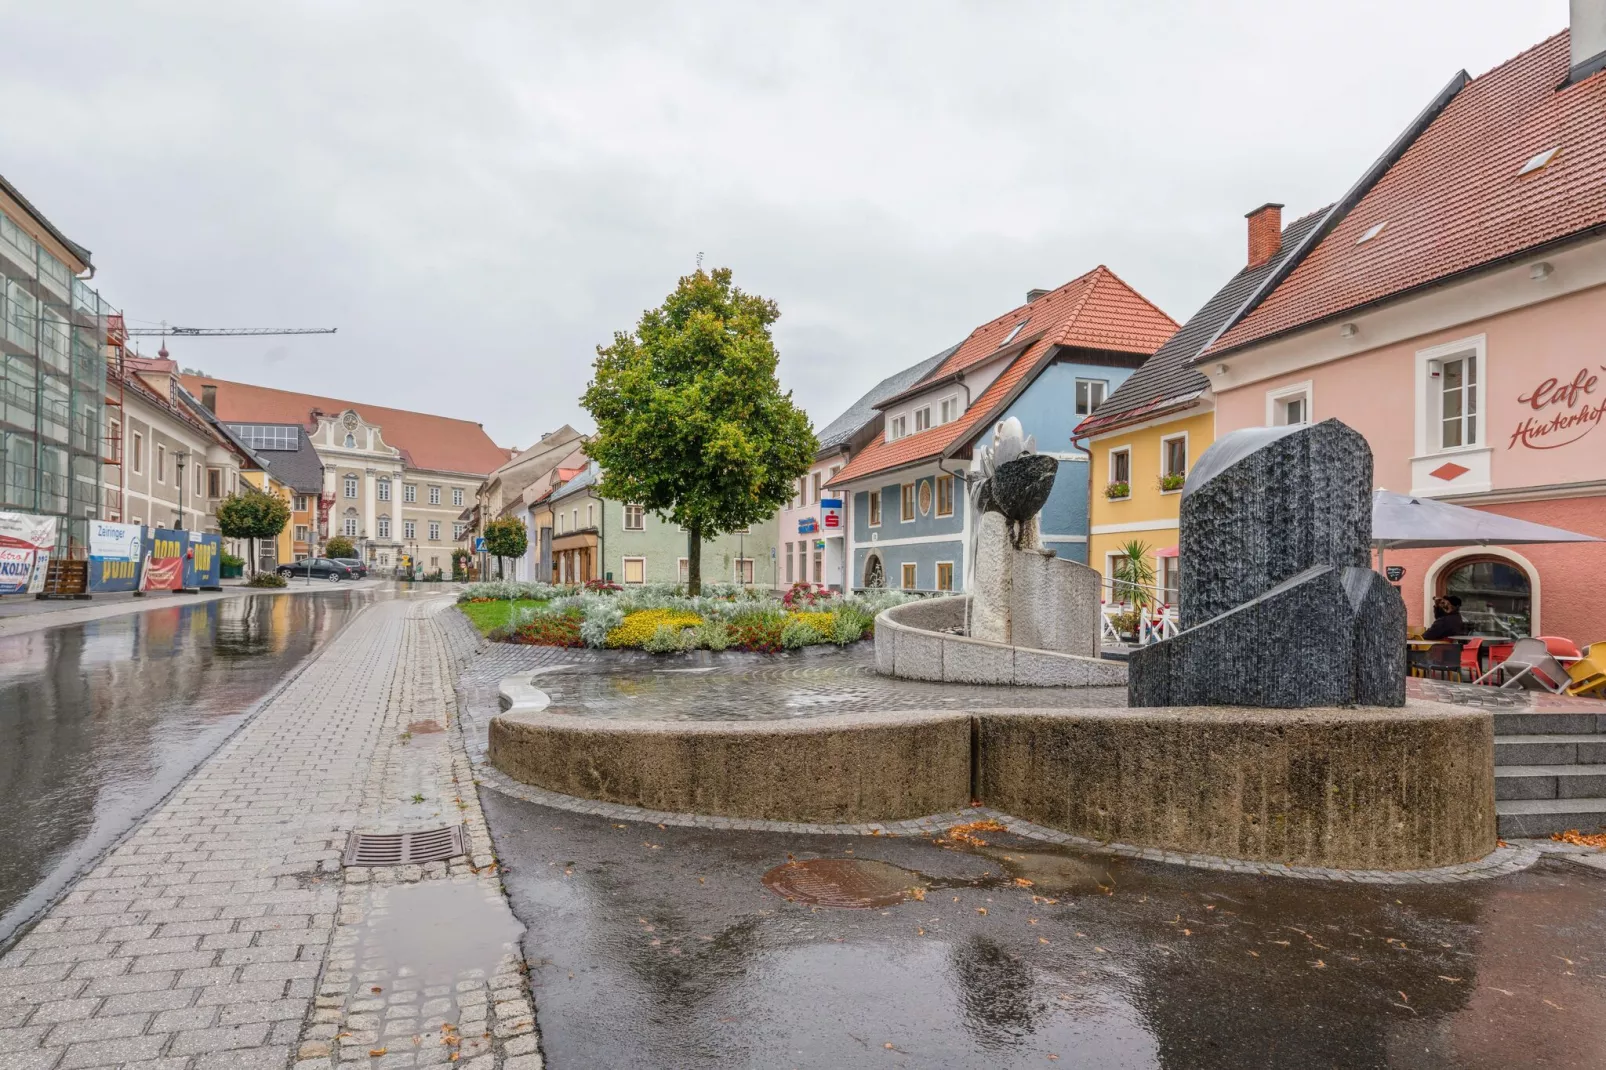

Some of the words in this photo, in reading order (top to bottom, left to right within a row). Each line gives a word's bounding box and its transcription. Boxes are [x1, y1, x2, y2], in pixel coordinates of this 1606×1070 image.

[97, 524, 126, 541] Zeiringer
[0, 550, 21, 560] ktro
[0, 562, 31, 576] KOLIN
